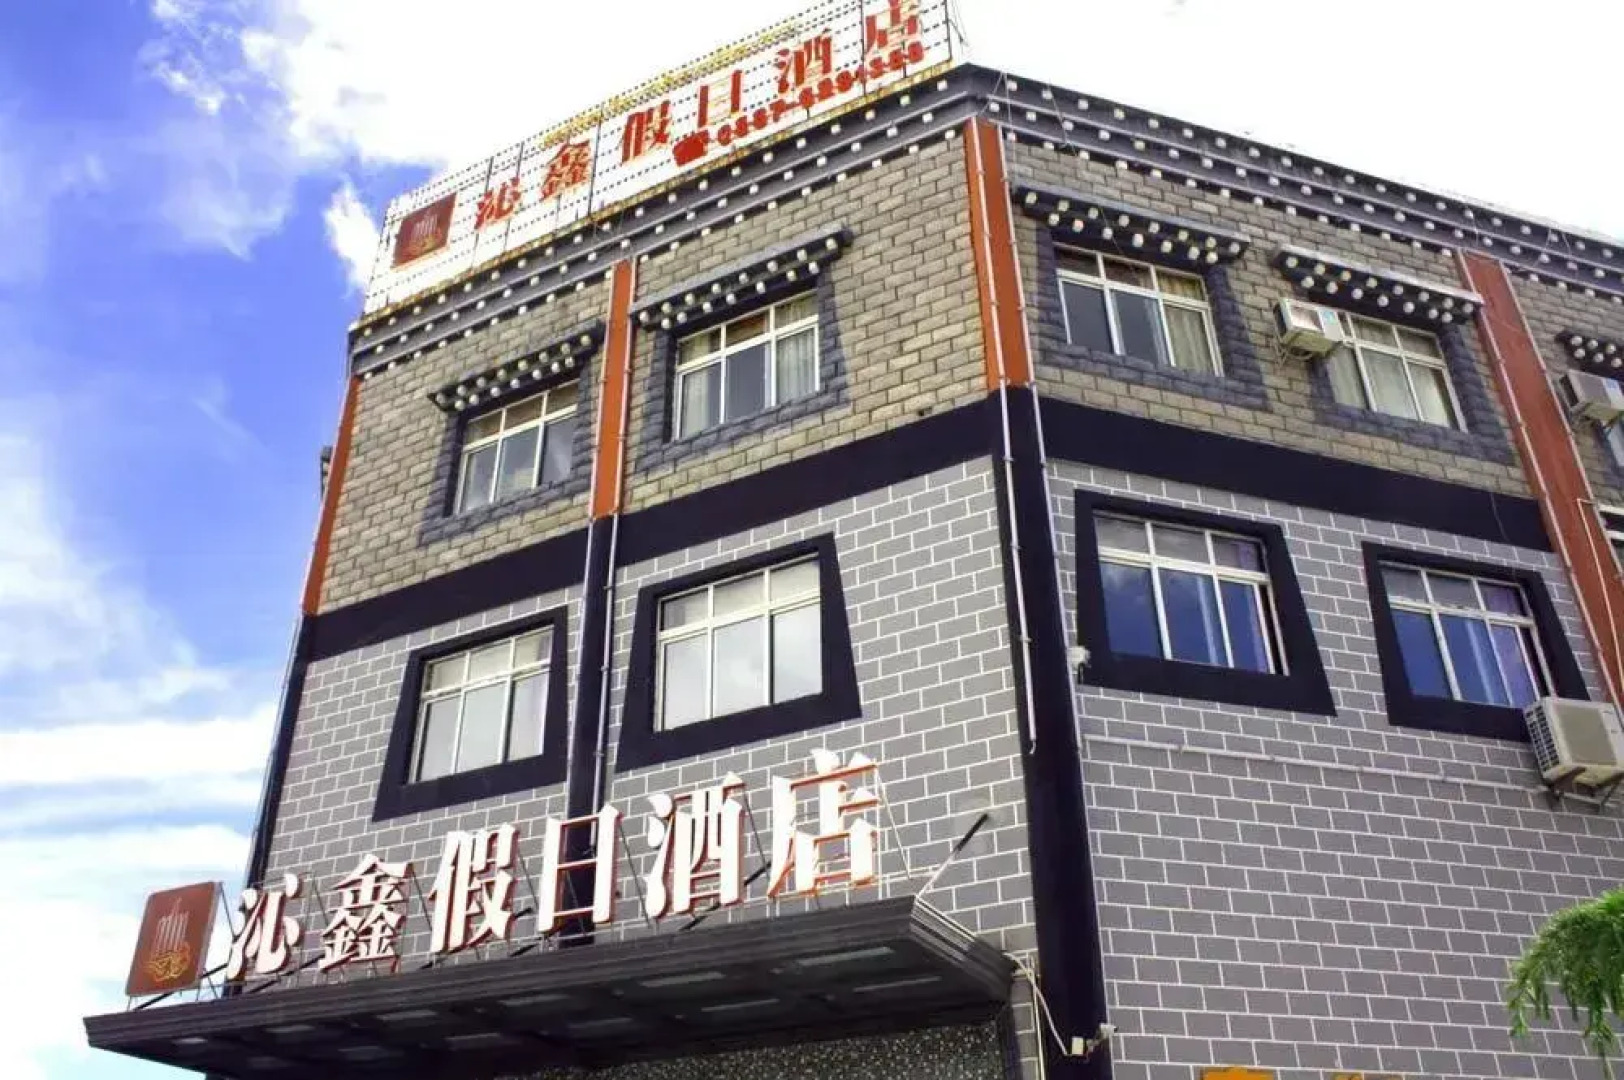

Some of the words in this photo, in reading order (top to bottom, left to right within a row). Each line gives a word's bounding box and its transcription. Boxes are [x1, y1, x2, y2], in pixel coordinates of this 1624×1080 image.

[474, 0, 922, 230] 沁鑫假日酒店
[226, 748, 880, 981] 沁鑫假日酒店
